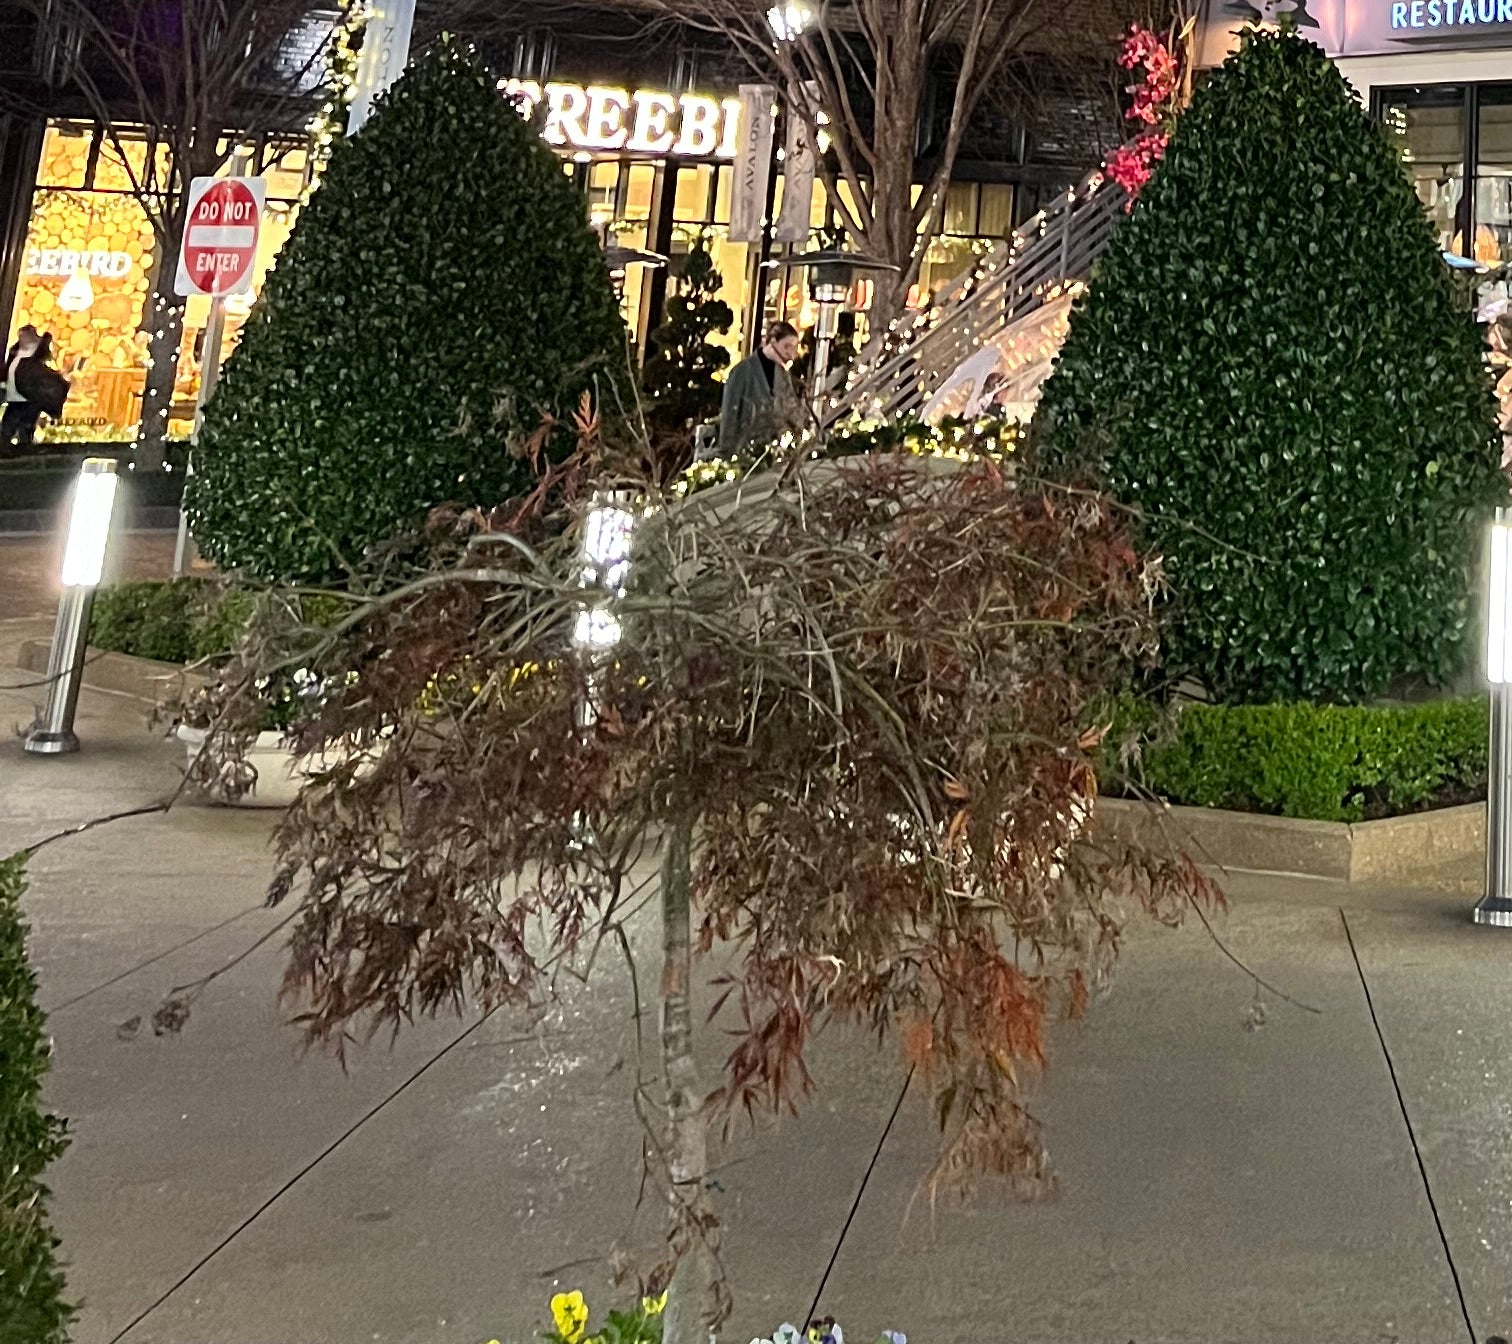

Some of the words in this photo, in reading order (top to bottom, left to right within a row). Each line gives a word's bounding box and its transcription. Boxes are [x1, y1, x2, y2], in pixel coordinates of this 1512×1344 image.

[744, 115, 761, 191] AVALON
[198, 201, 220, 220] DO
[222, 201, 253, 223] NOT
[195, 252, 241, 272] ENTER
